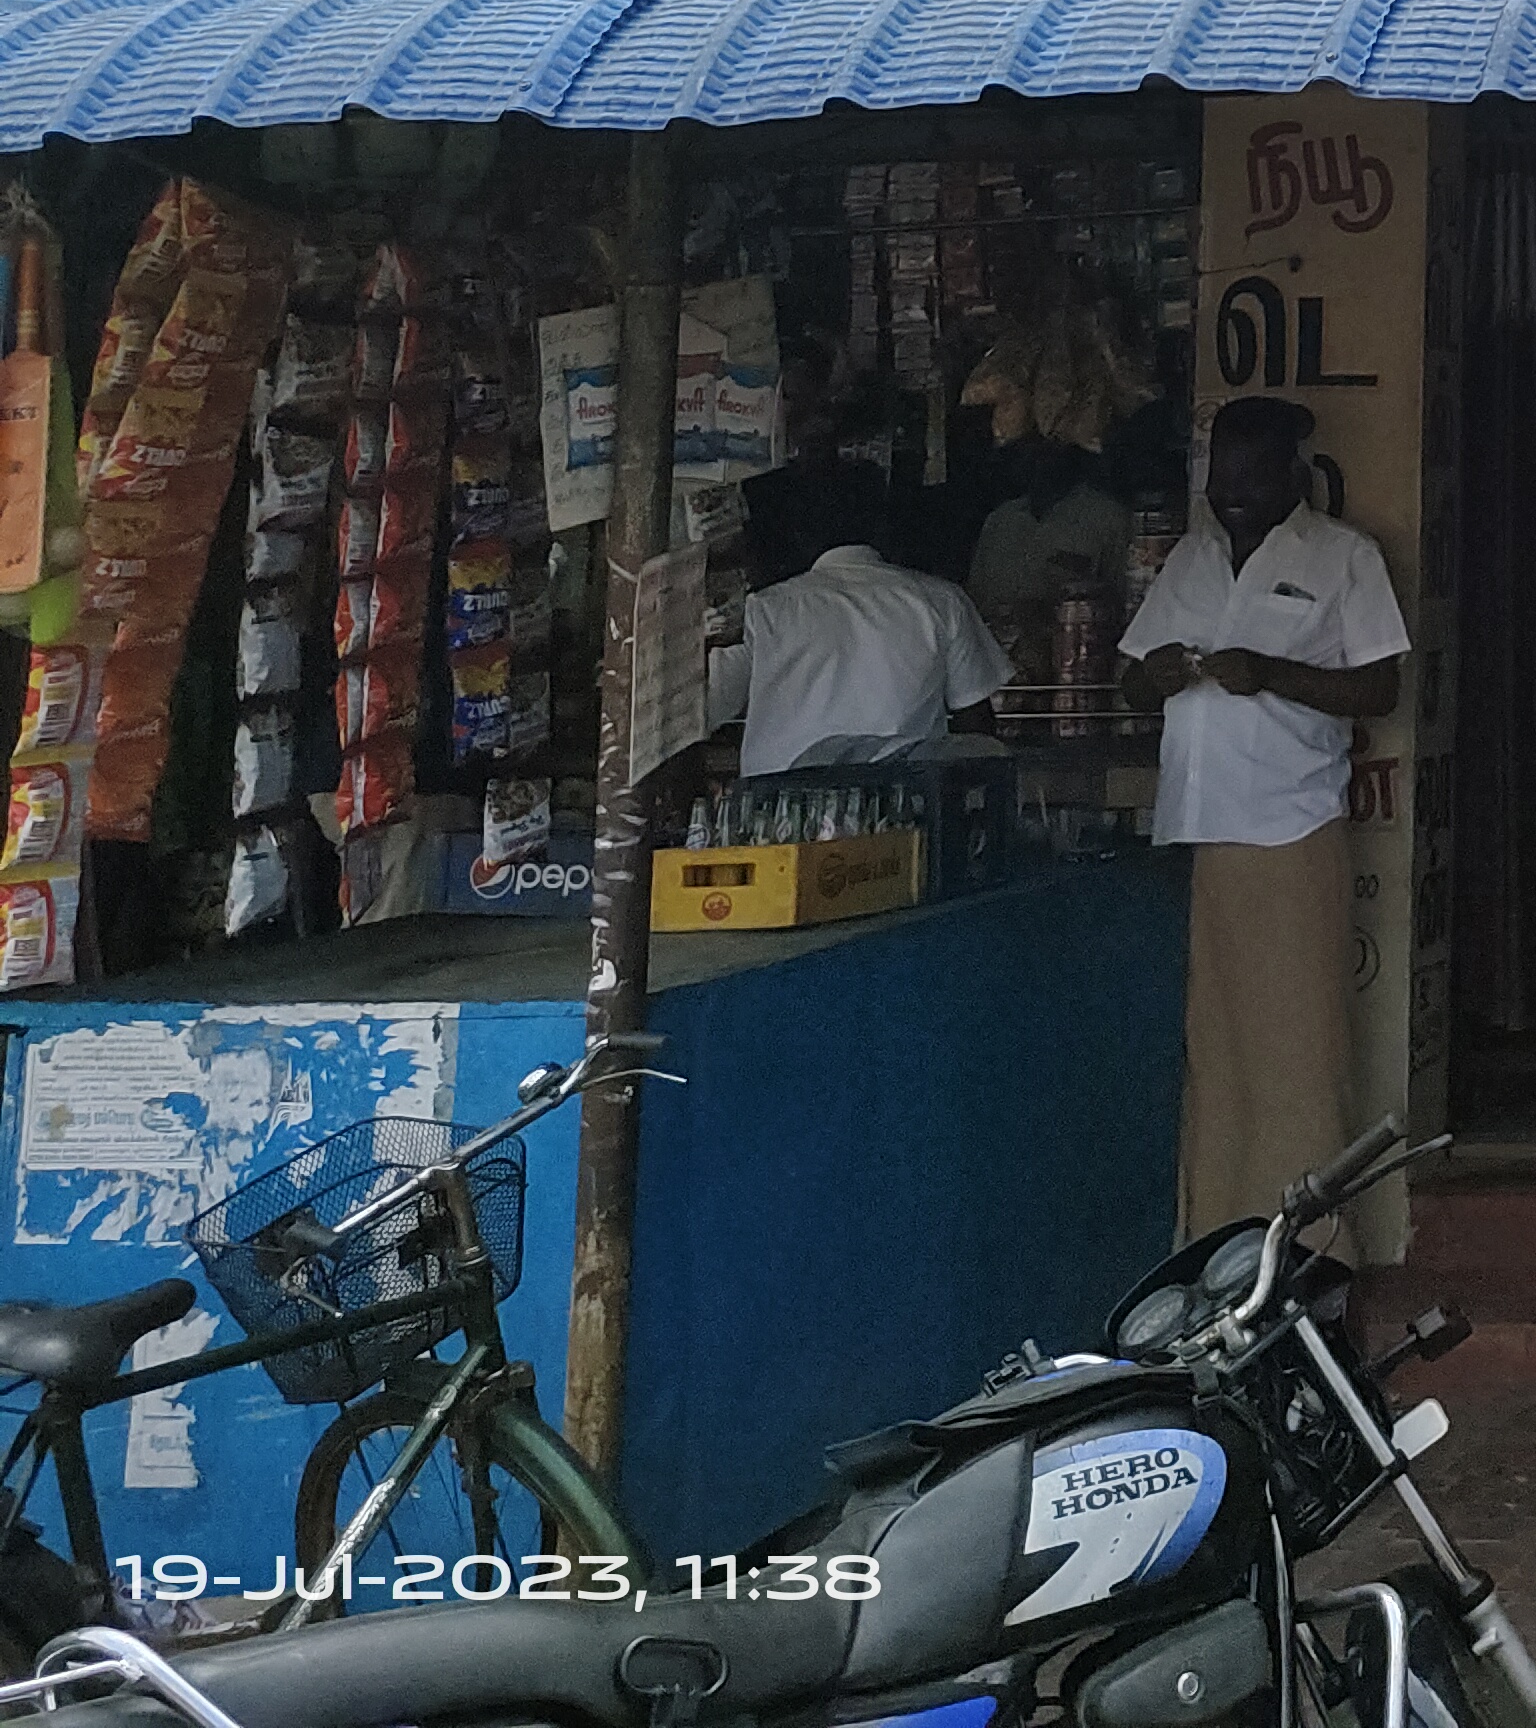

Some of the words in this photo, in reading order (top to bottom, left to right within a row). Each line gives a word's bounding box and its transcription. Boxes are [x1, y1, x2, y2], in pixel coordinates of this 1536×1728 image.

[514, 861, 596, 898] pep
[1060, 1446, 1181, 1493] HERO
[1052, 1467, 1200, 1521] HONDA
